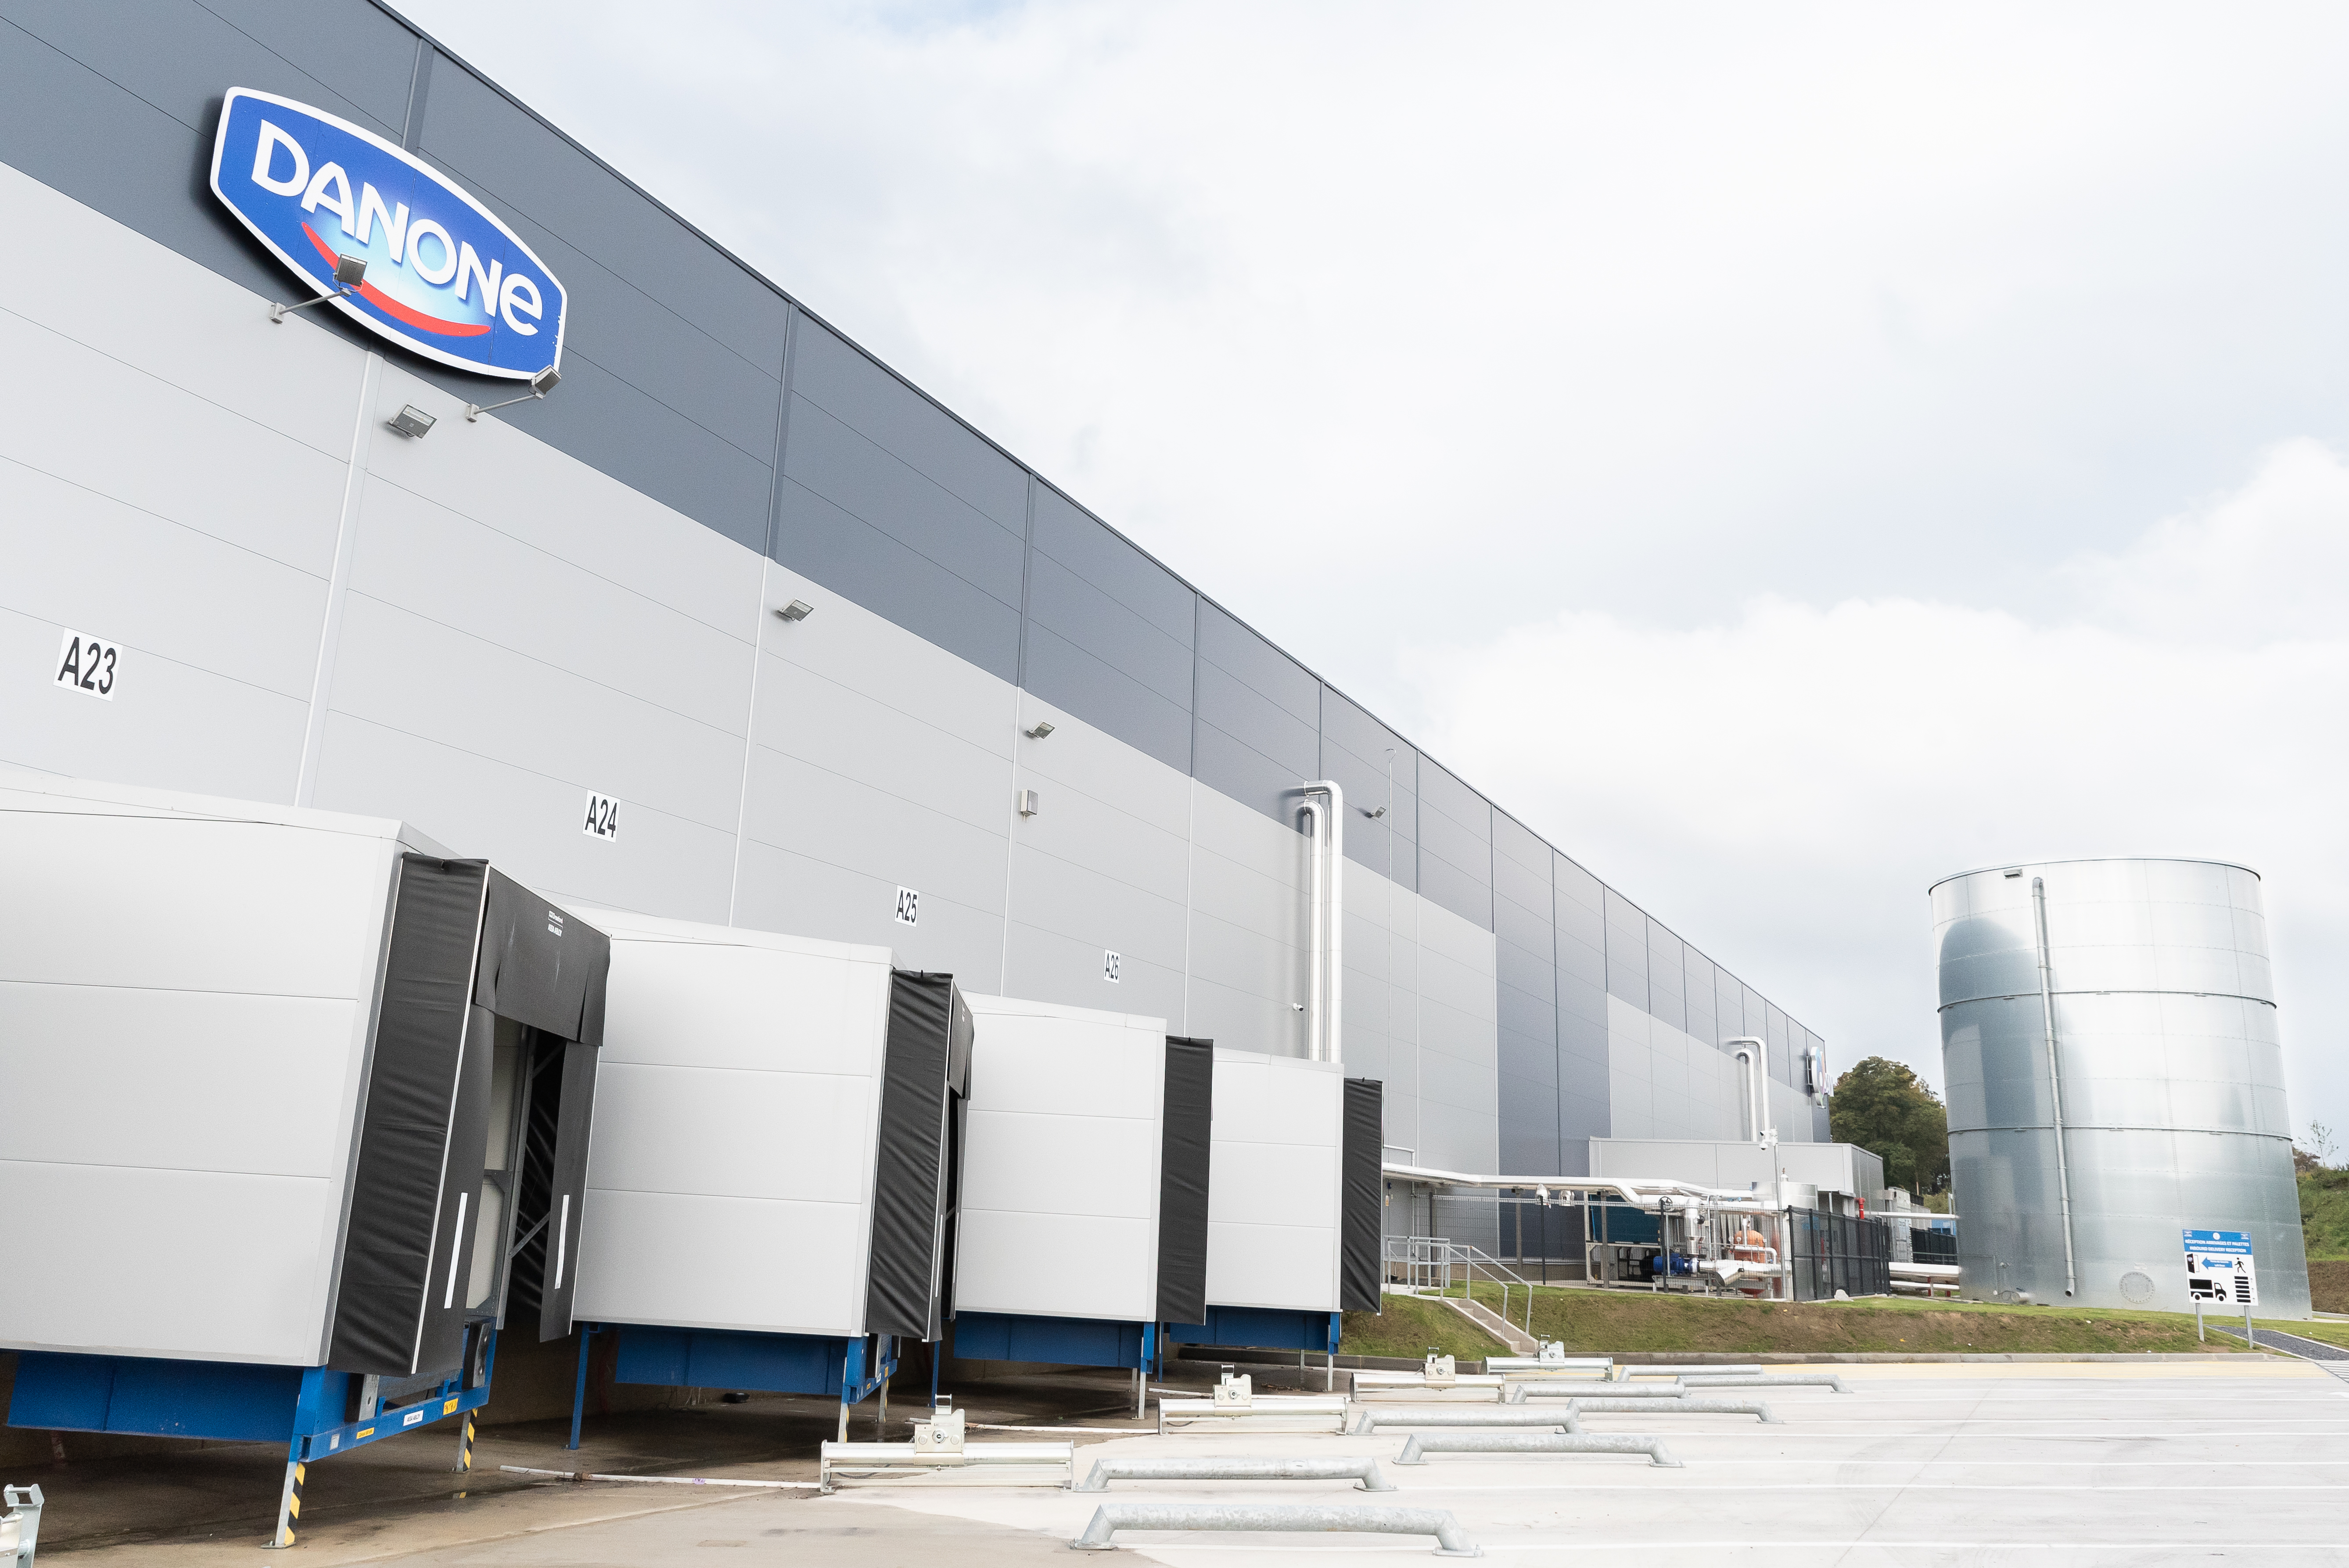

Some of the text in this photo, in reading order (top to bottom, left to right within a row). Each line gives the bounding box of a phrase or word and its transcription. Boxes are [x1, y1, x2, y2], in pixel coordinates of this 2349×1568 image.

[57, 636, 116, 694] A23
[585, 796, 617, 838] A24
[896, 890, 917, 923] A25
[554, 927, 563, 937] ABLOY
[1105, 953, 1119, 980] A26
